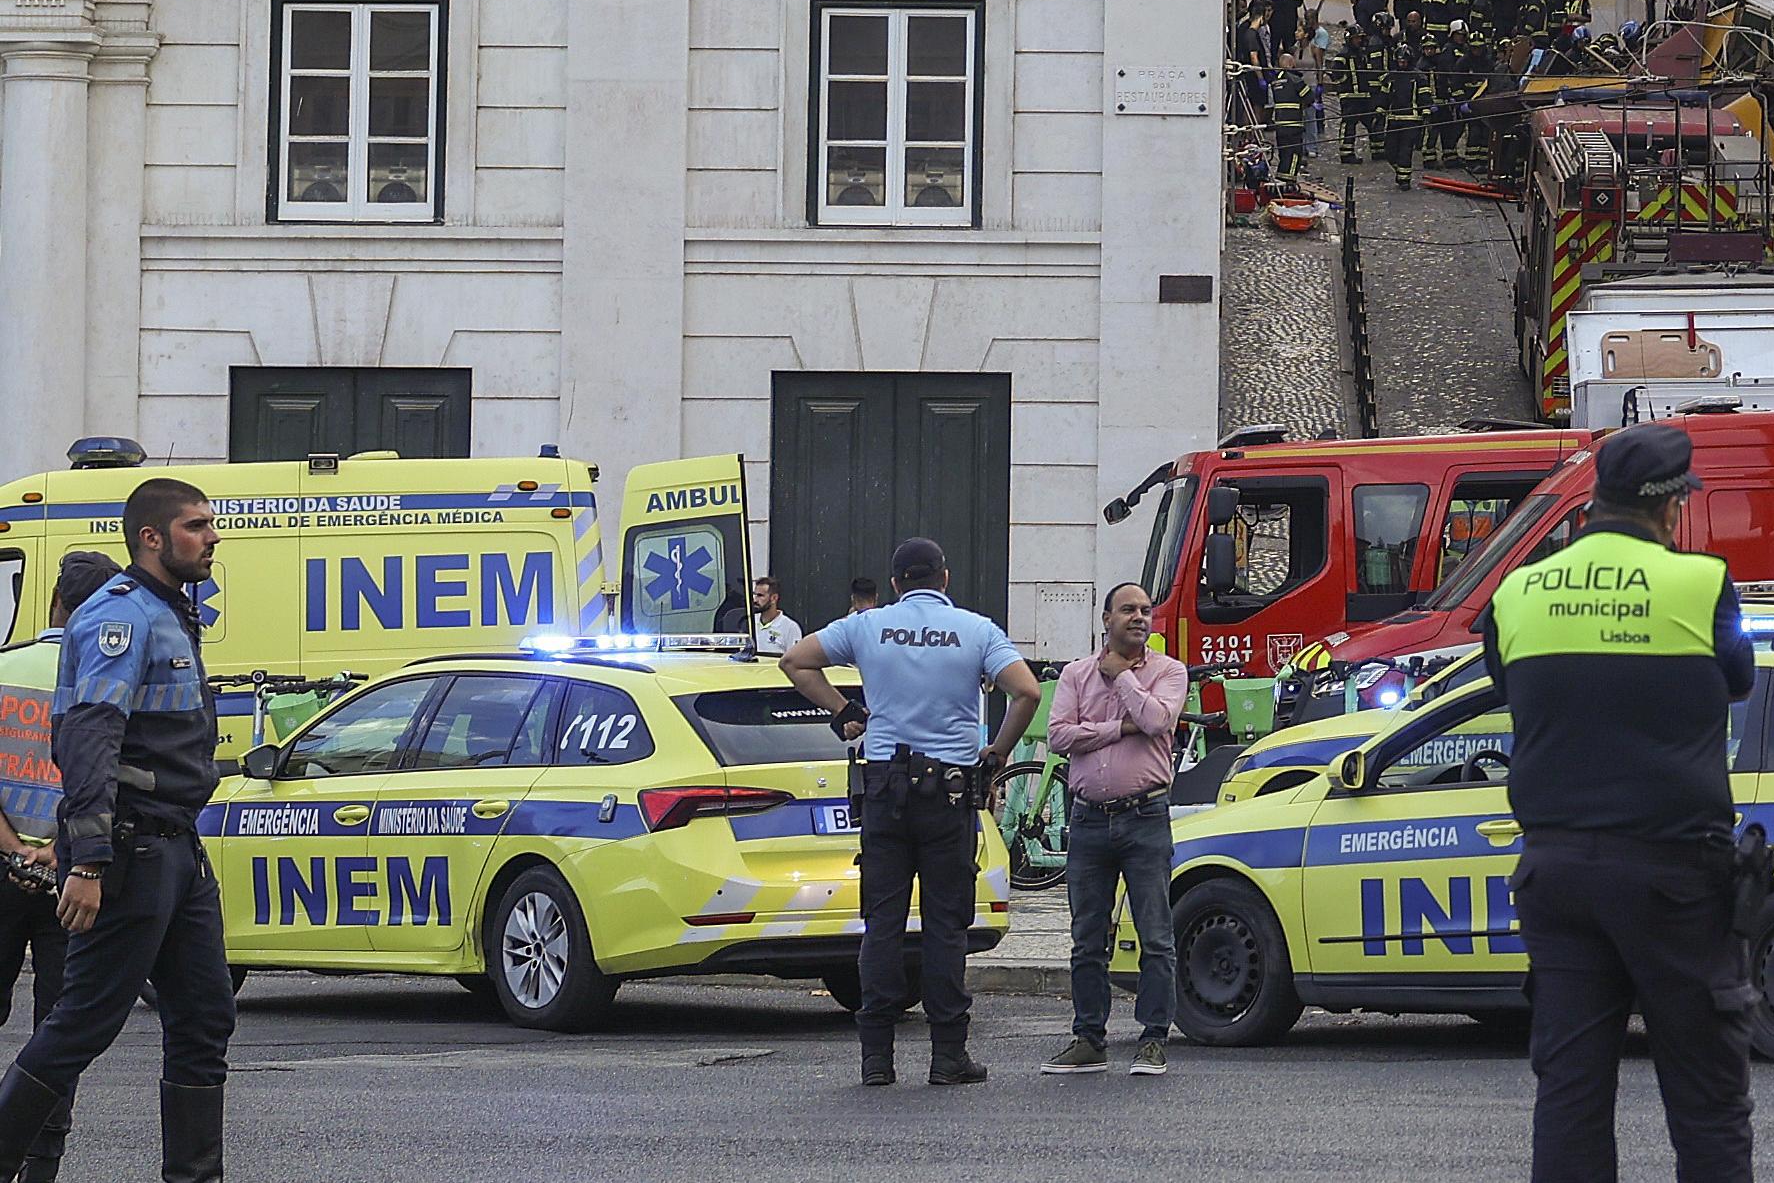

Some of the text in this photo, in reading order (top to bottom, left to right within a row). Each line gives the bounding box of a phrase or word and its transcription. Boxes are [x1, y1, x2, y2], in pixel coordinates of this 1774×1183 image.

[305, 497, 331, 512] DA
[287, 515, 310, 528] DE
[316, 511, 430, 527] EMERGÊNCIA
[438, 509, 504, 525] MÉDICA
[1523, 562, 1650, 595] POLÍCIA
[305, 552, 554, 632] INEM
[1549, 598, 1650, 621] municipal
[880, 626, 961, 647] POLÍCIA
[1201, 634, 1252, 649] 2101
[1600, 629, 1650, 643] Lisboa
[1201, 649, 1253, 663] VSAT
[576, 715, 637, 751] 112
[238, 803, 319, 835] EMERGÊNCIA
[379, 801, 468, 834] MINISTÉRIO DA SAÚDE
[1340, 825, 1459, 854] EMERGÊNCIA
[252, 856, 452, 926] INEM
